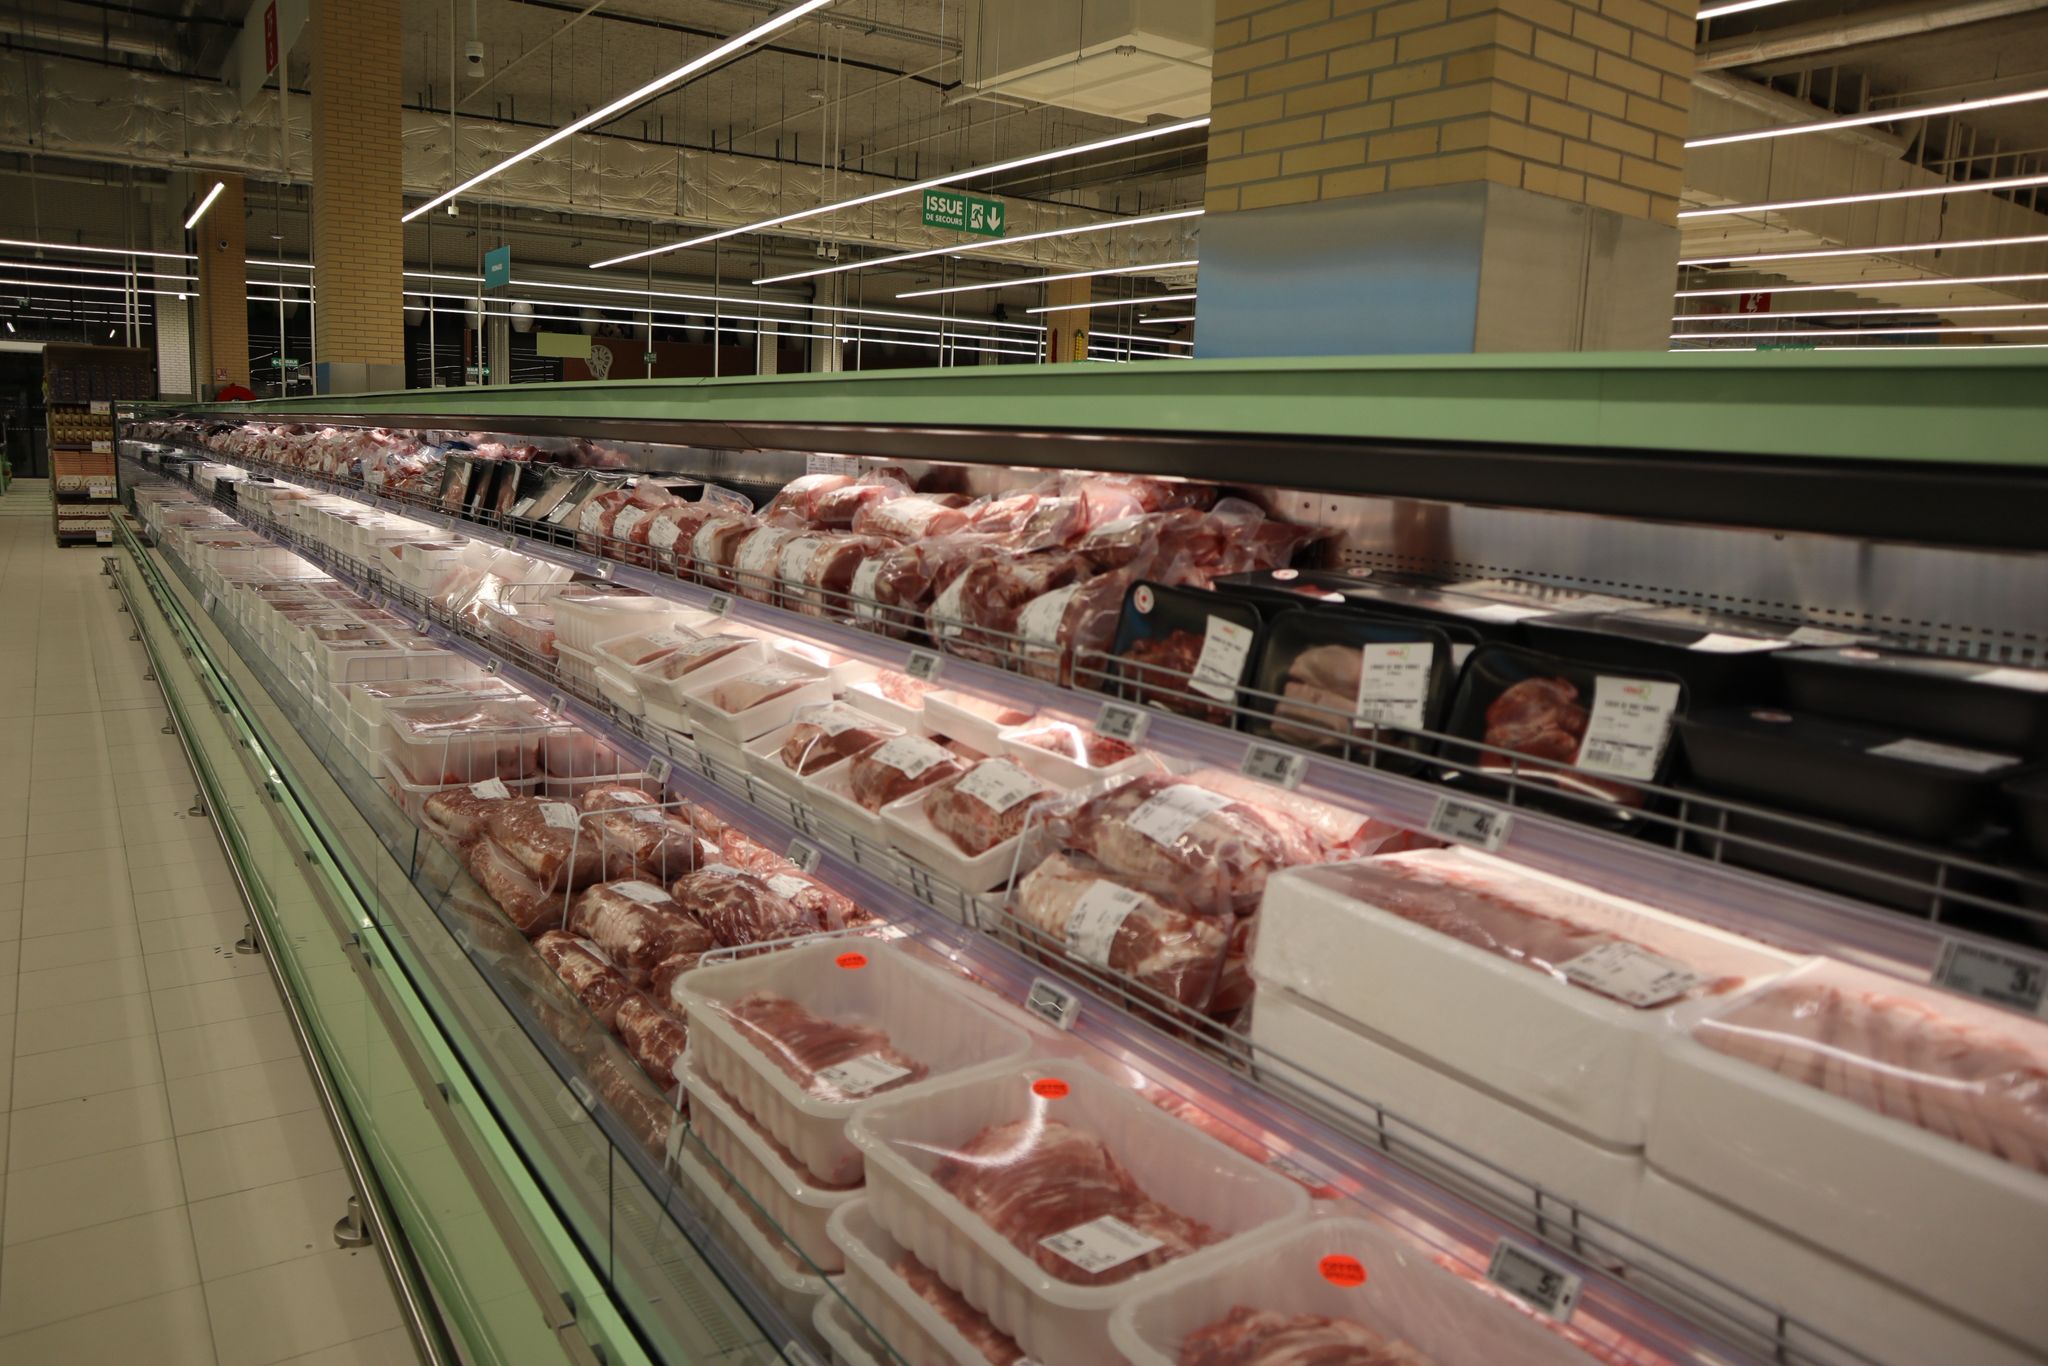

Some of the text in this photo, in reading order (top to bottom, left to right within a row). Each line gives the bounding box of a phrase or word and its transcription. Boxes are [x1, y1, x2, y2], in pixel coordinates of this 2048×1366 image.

[926, 195, 963, 216] ISSUE
[925, 213, 963, 226] DE SECOURS
